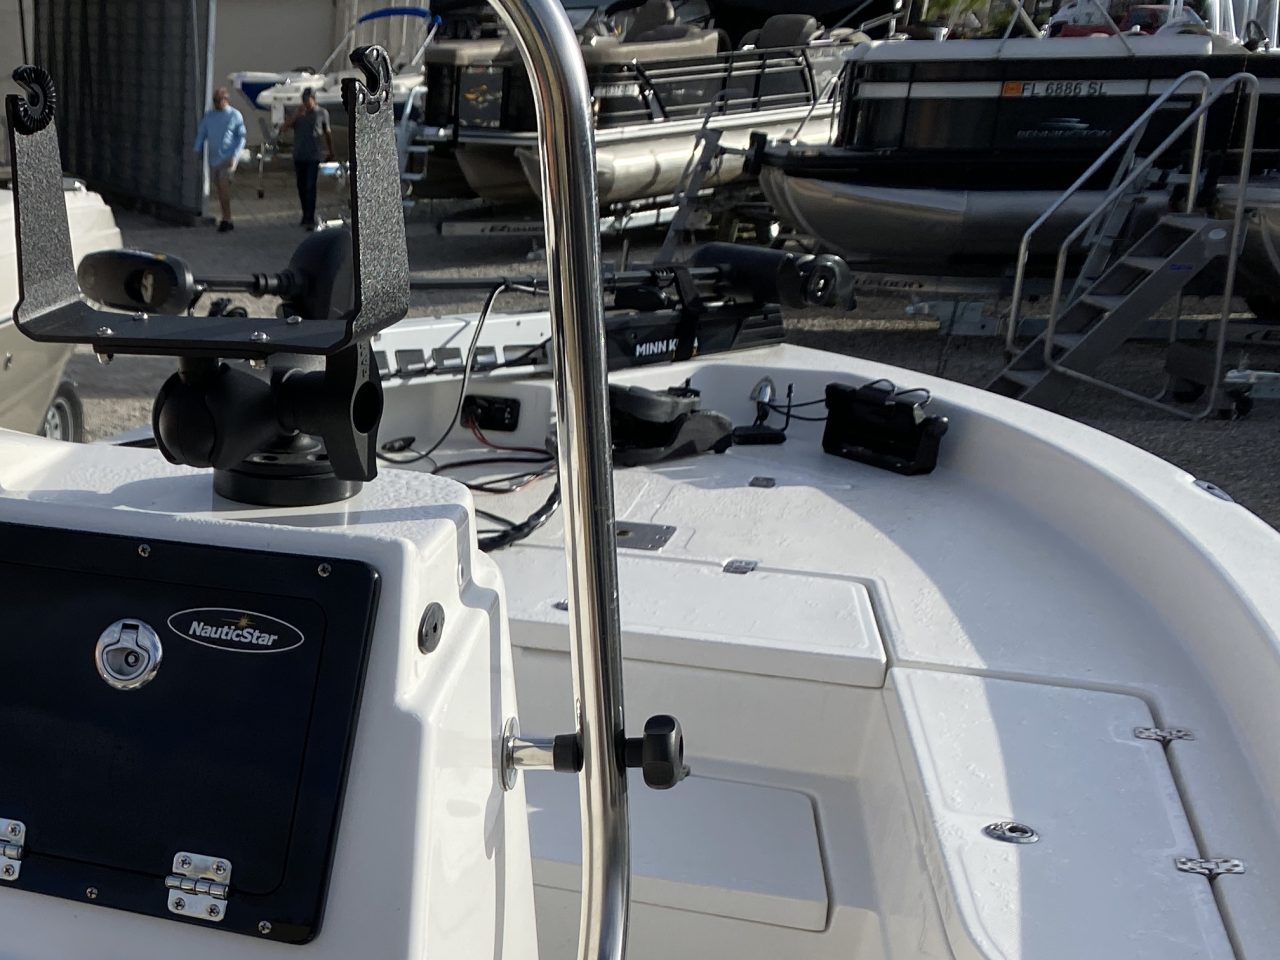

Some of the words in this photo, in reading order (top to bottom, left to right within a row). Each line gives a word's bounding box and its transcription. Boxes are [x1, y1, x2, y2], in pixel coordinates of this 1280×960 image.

[1022, 82, 1041, 95] FL
[1045, 82, 1083, 95] 6886
[1087, 82, 1108, 95] SL
[636, 340, 667, 356] MINN
[189, 621, 278, 646] NauticStar
